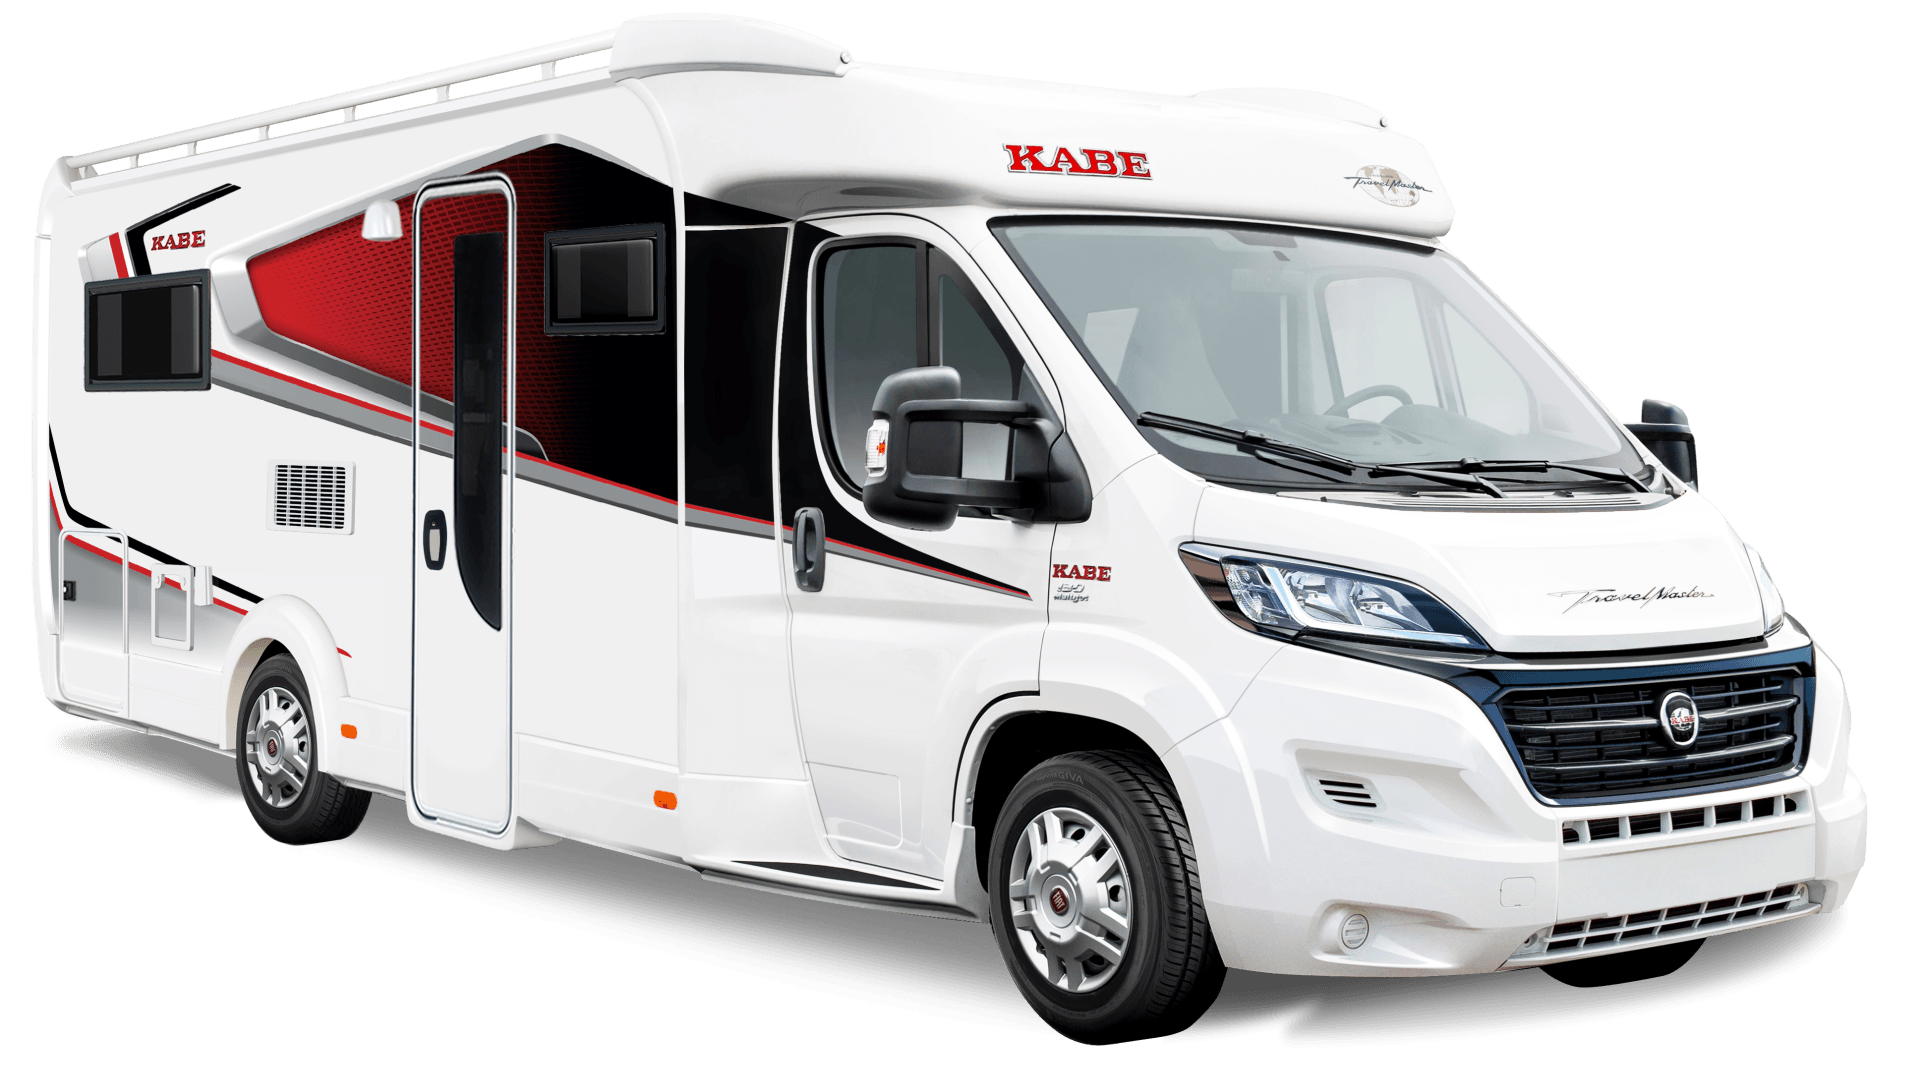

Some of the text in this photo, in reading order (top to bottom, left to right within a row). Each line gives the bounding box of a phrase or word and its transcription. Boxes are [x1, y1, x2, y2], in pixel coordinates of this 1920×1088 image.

[1002, 143, 1153, 180] KABE
[151, 230, 206, 251] KABE
[1052, 564, 1112, 582] KABE
[1052, 890, 1066, 910] FIAT
